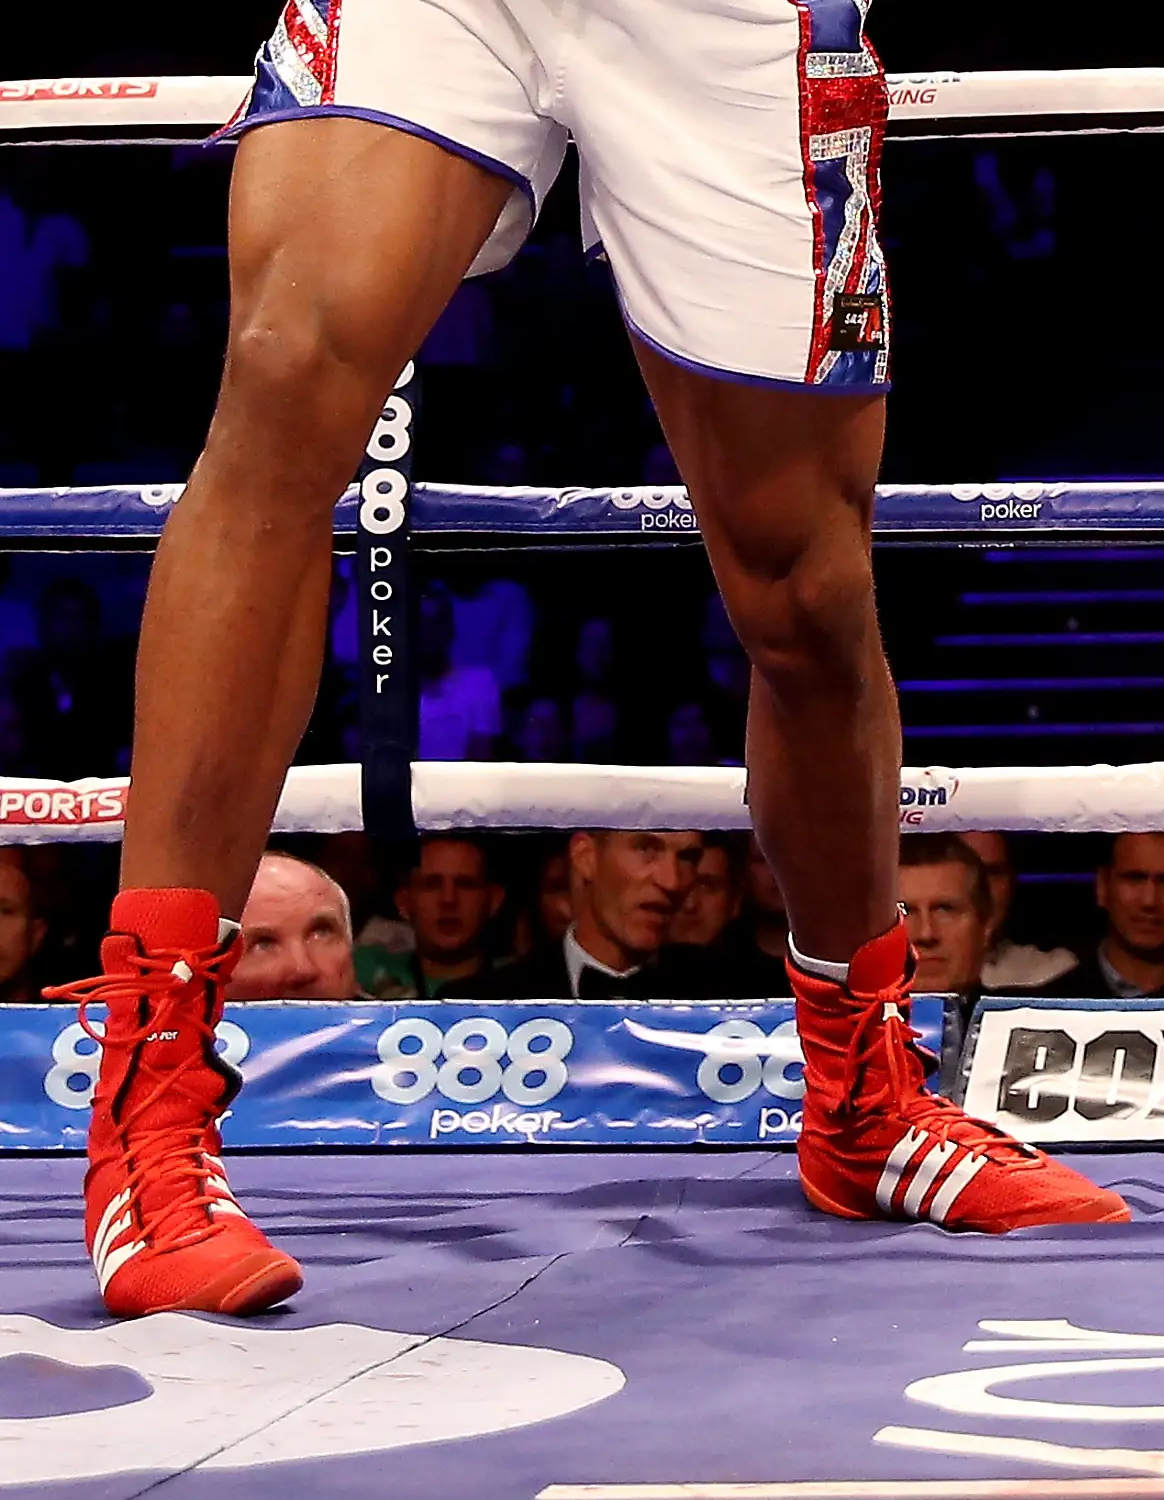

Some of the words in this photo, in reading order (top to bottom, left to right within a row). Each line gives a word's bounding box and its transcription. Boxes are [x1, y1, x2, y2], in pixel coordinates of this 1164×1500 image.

[981, 499, 1042, 521] poker
[370, 546, 393, 694] poker
[371, 1017, 575, 1107] 888
[430, 1104, 562, 1139] poker
